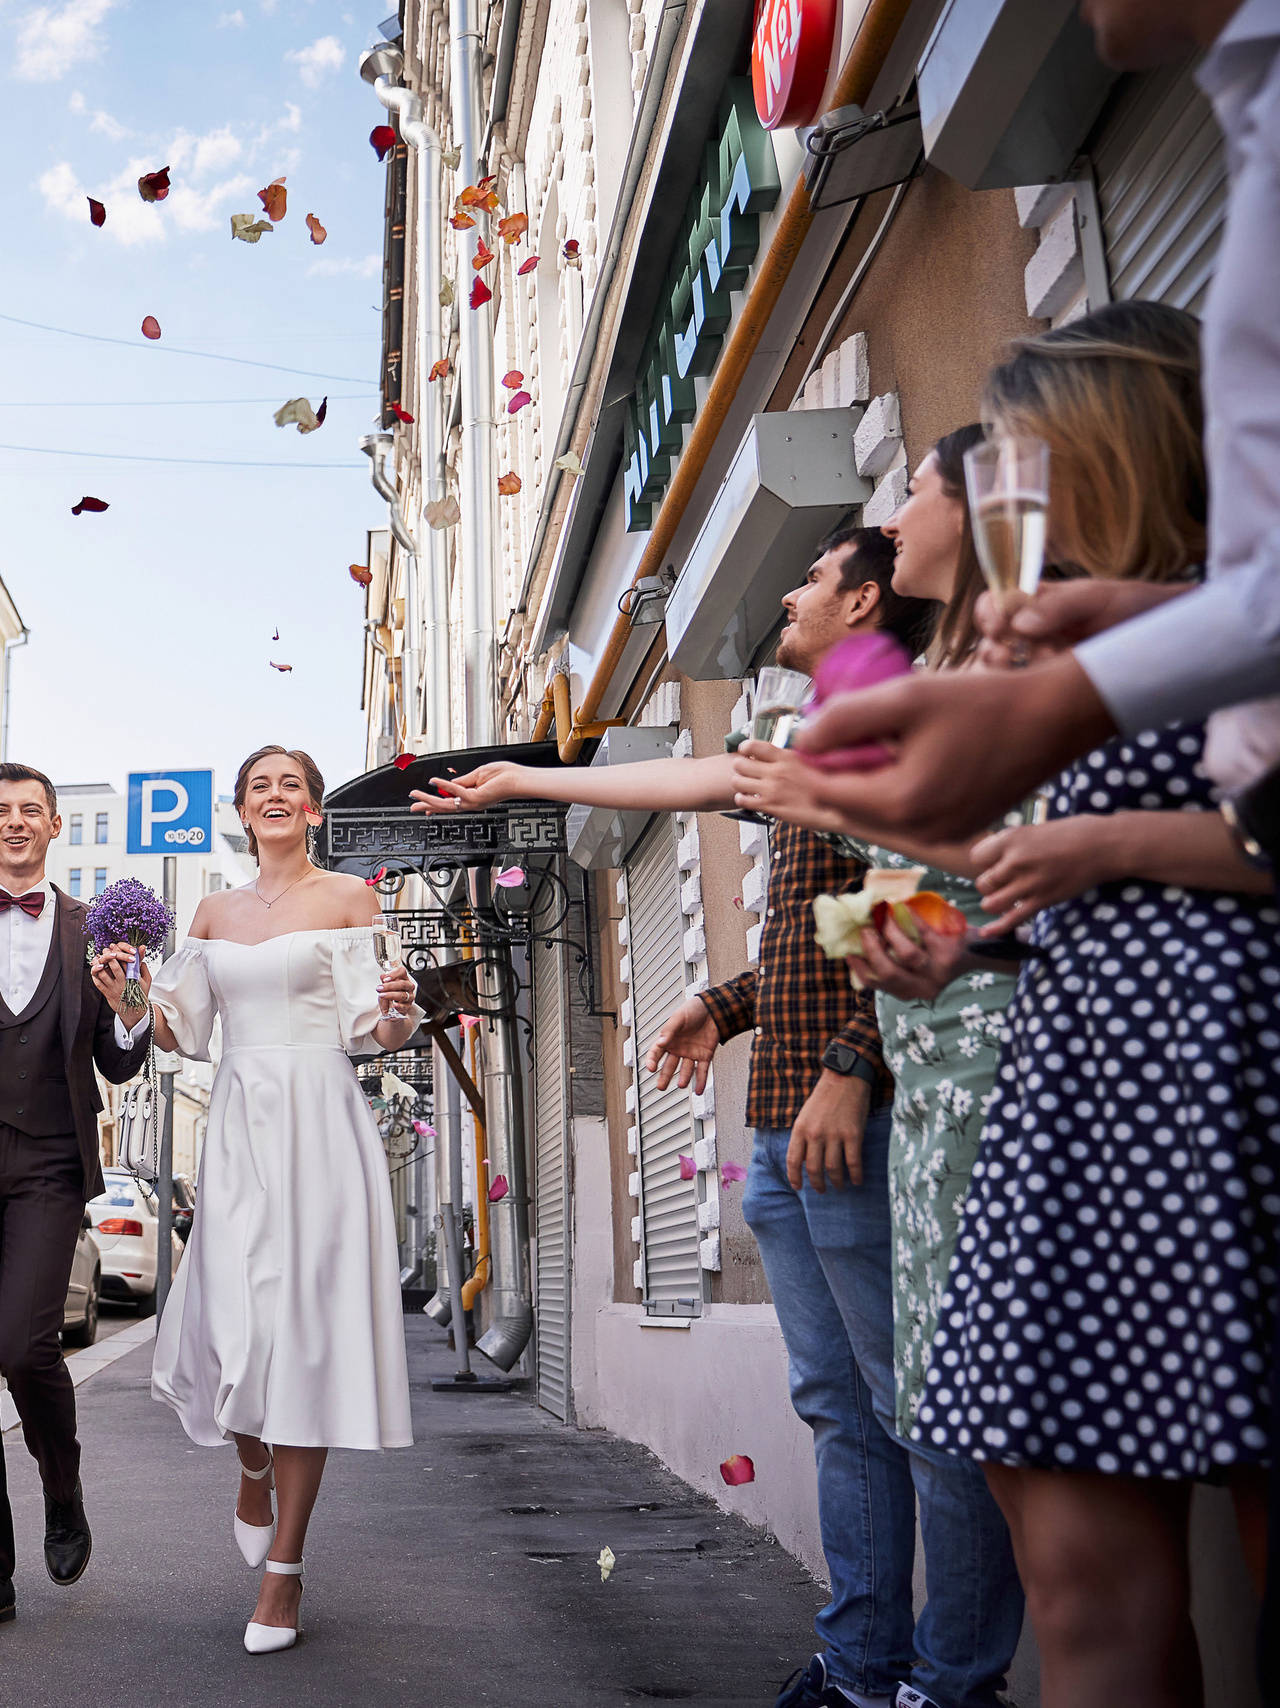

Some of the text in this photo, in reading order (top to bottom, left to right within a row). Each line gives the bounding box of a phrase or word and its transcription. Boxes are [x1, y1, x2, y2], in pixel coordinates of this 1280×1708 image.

[624, 104, 752, 533] АПТЕКА
[140, 779, 189, 847] P
[189, 831, 204, 841] 20
